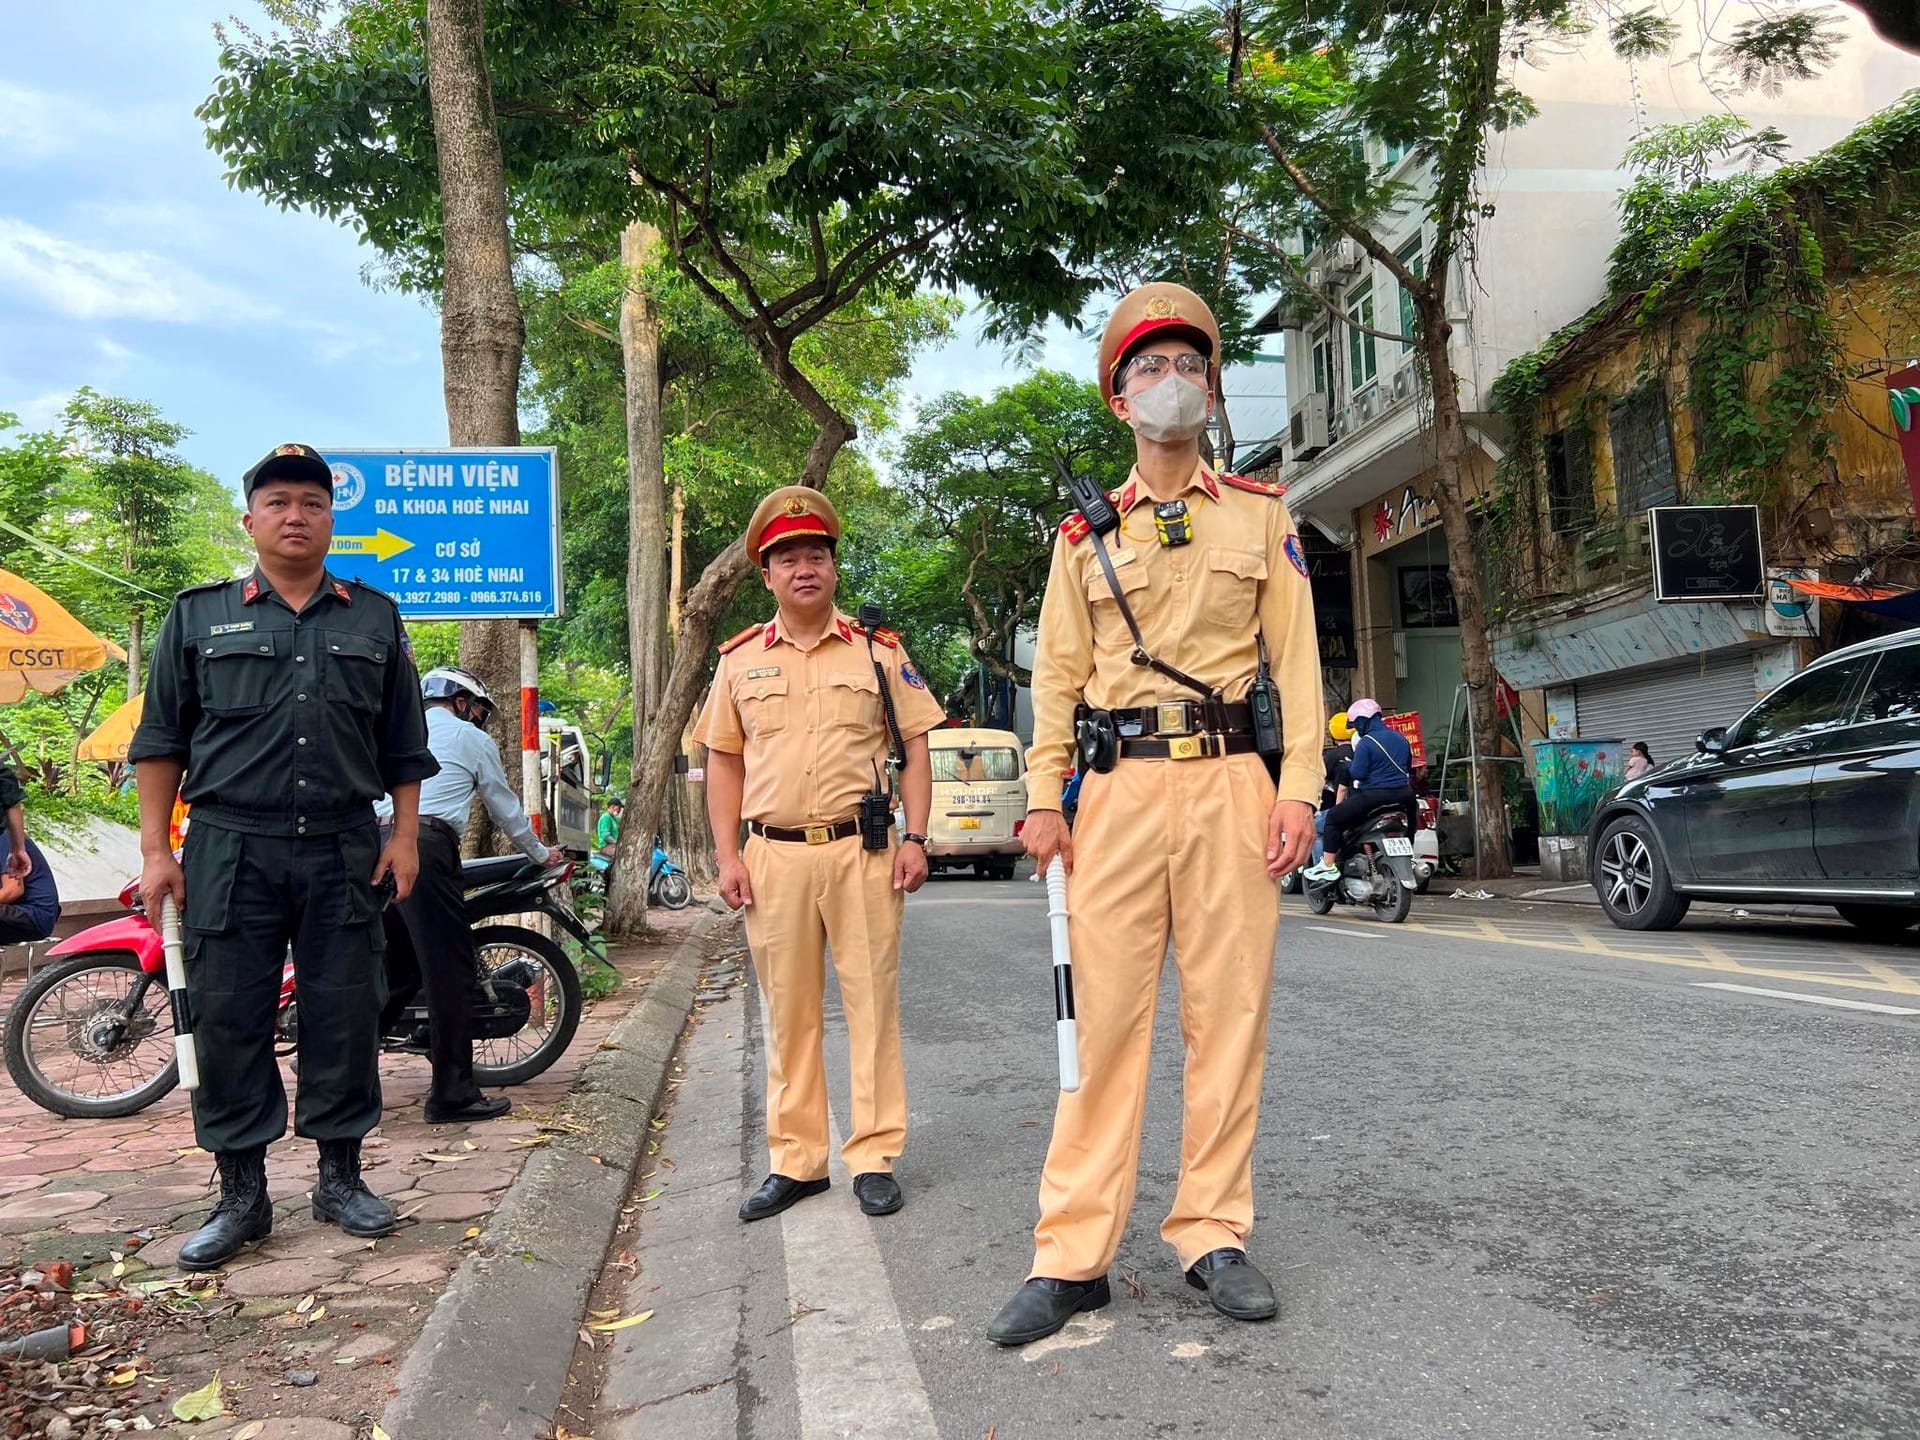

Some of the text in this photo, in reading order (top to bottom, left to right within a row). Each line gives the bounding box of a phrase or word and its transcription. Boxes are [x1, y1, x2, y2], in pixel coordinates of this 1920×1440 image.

[385, 460, 453, 492] BỆNH
[461, 461, 519, 492] VIỆN
[375, 496, 529, 515] ĐA KHOA HOÈ NHAI
[435, 537, 481, 558] CƠ SỞ
[392, 565, 524, 583] 17 & 34 HOÈ NHAI
[387, 591, 461, 604] 24.3927.2980
[470, 591, 542, 603] 0966.374.616
[9, 649, 64, 666] CSGT
